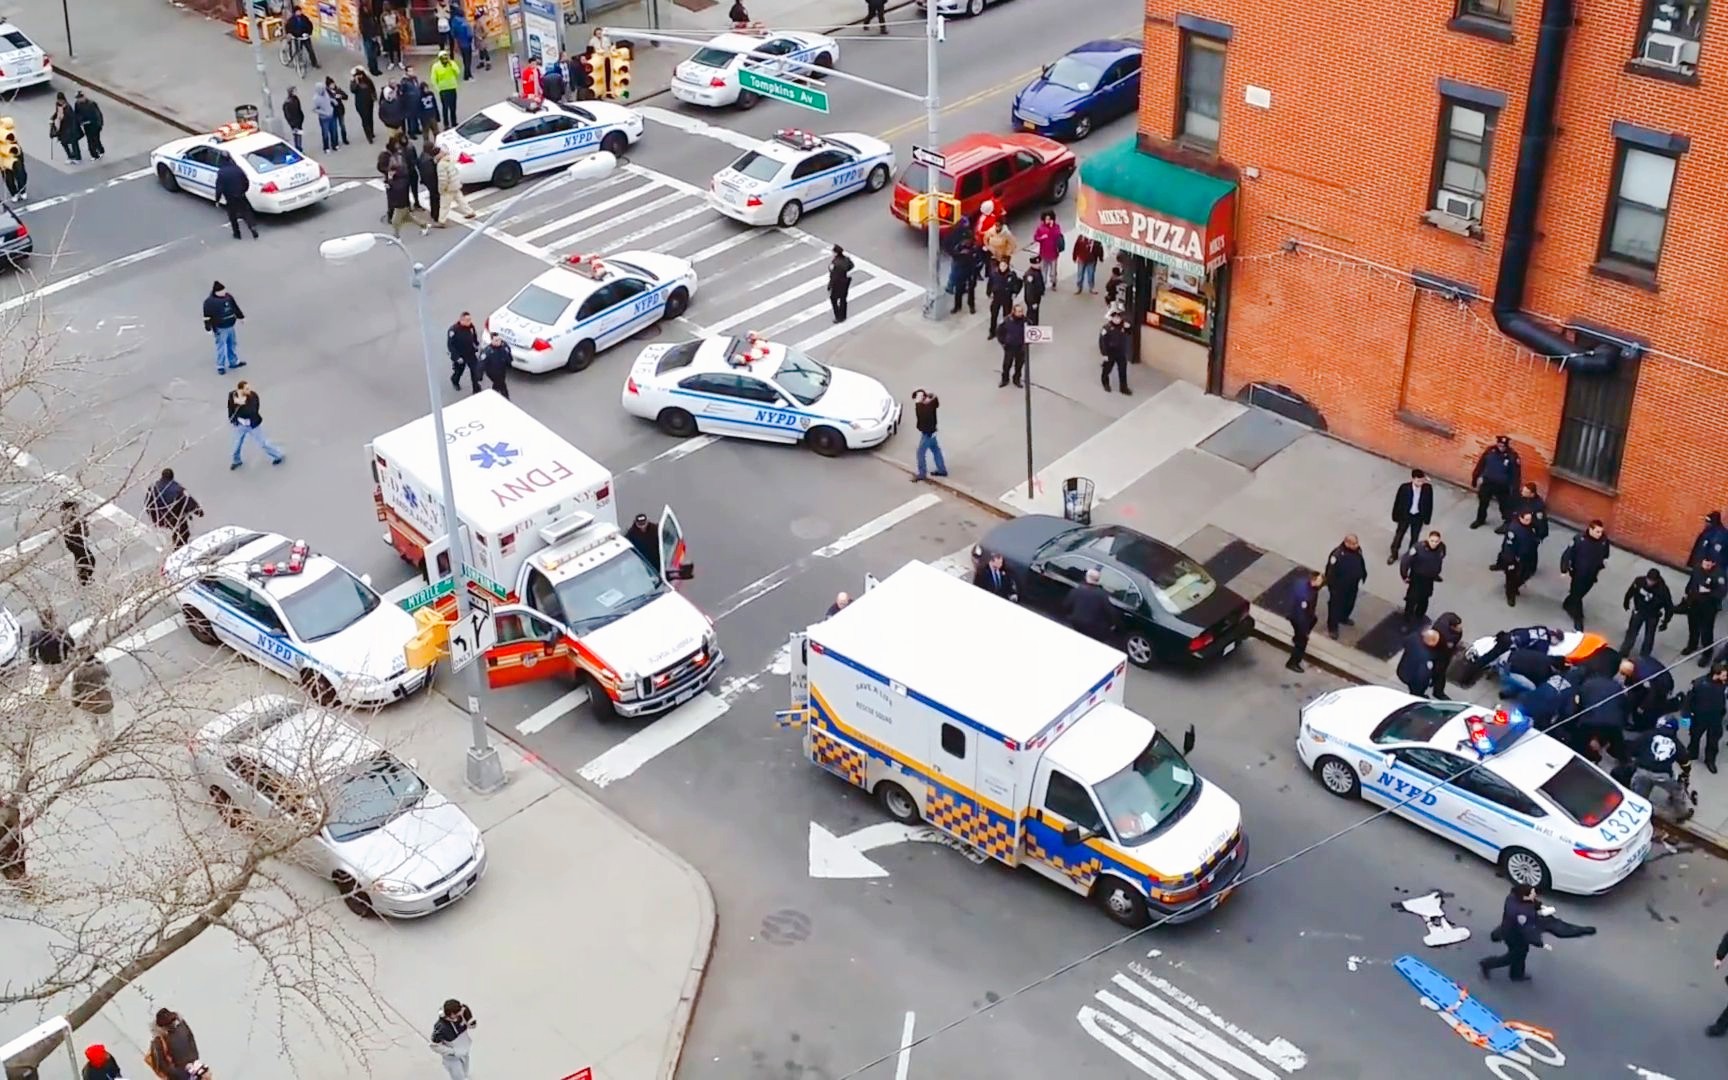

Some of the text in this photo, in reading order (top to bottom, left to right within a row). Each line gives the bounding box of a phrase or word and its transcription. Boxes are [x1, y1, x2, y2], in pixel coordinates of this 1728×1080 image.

[750, 75, 813, 105] Tompkins Av
[563, 131, 593, 148] NYPD
[176, 164, 198, 179] NYPD
[831, 169, 857, 187] NYPD
[1098, 208, 1130, 225] MIKE'S
[1130, 211, 1205, 261] PIZZA
[633, 291, 660, 316] NYPD
[754, 408, 797, 427] NYPD
[490, 459, 574, 508] FDNY
[407, 584, 440, 609] MYRTLE
[257, 632, 292, 662] NYPD
[454, 651, 473, 668] ONLY
[1377, 771, 1438, 807] NYPD
[1599, 800, 1649, 843] 4324
